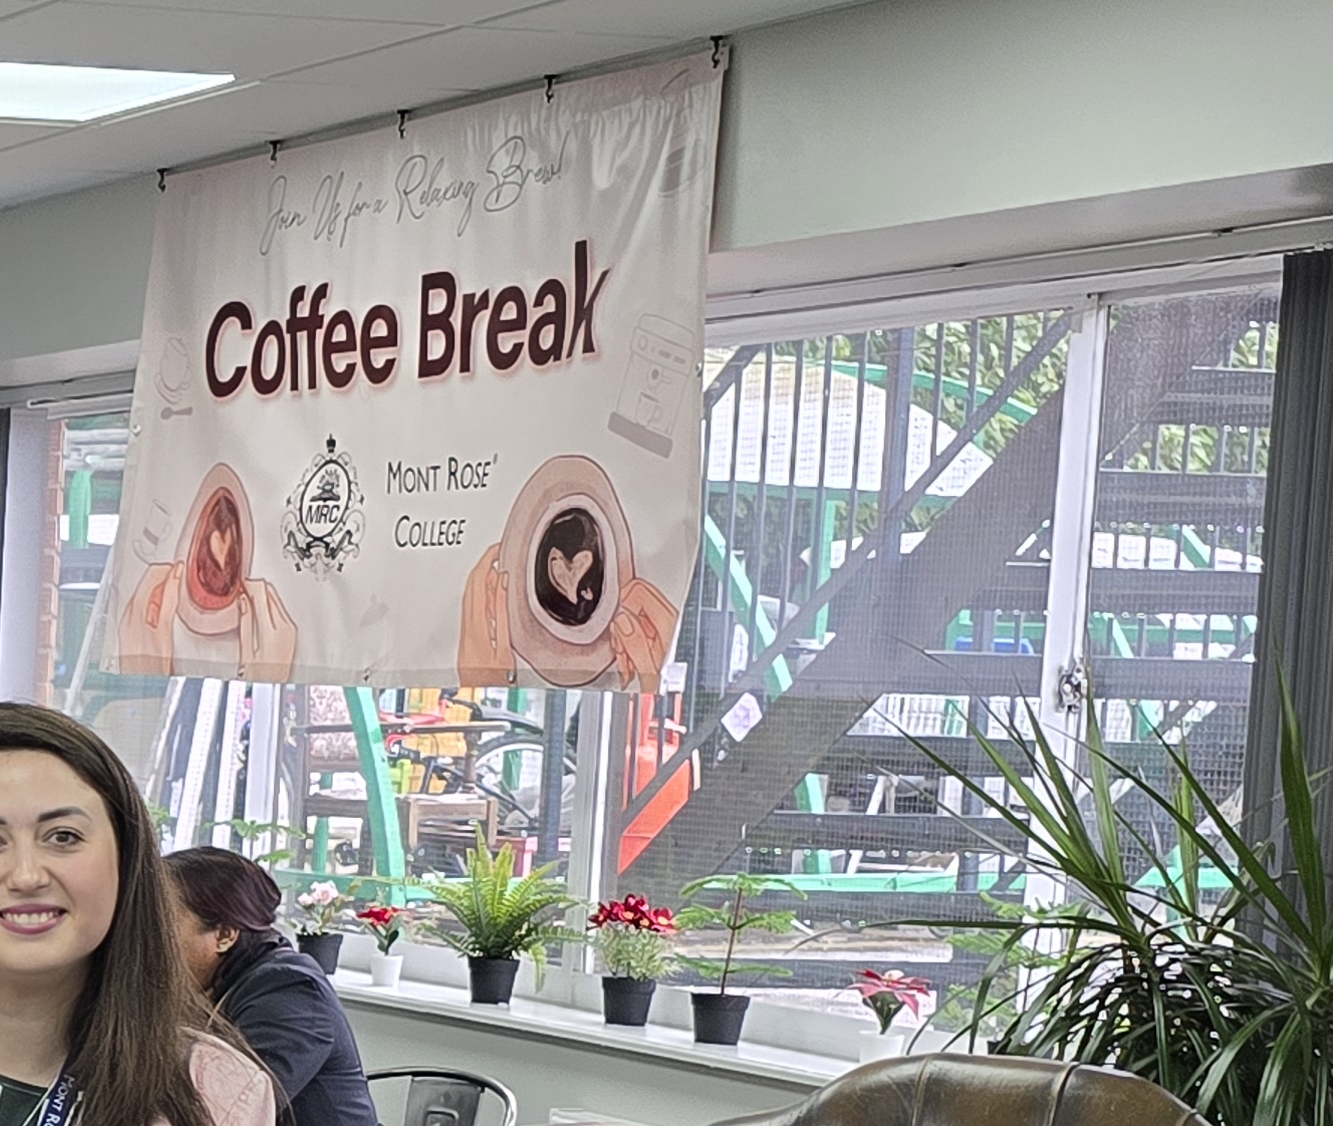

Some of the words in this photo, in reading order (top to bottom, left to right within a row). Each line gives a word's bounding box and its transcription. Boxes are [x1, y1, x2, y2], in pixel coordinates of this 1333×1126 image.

[260, 175, 306, 255] Join
[339, 181, 370, 248] for
[373, 199, 387, 214] a
[395, 154, 475, 237] Relaxing
[205, 282, 398, 398] Coffee
[417, 239, 610, 379] Break
[386, 461, 441, 494] MONT
[305, 504, 340, 525] MRC
[394, 515, 466, 548] COLLEGE
